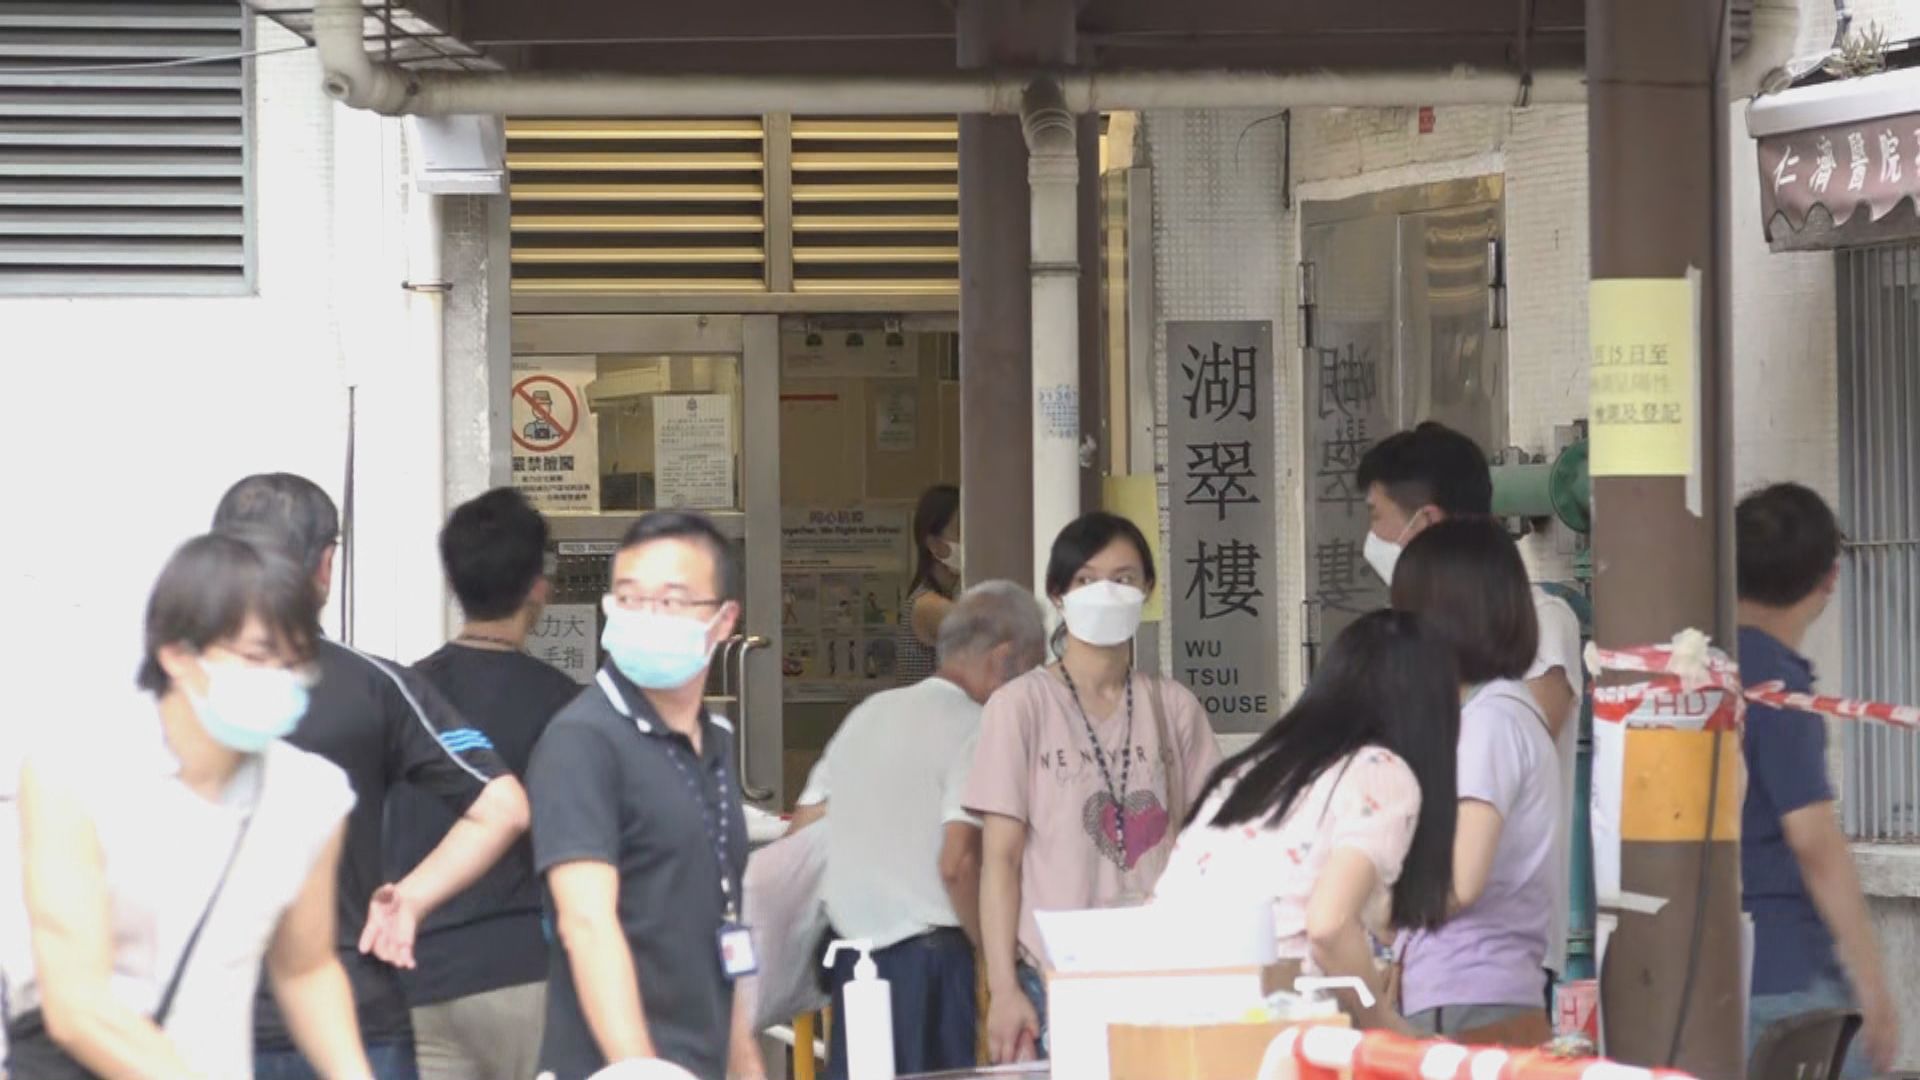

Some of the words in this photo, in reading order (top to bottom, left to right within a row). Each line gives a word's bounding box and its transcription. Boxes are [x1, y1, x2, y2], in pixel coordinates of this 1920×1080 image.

[1773, 128, 1920, 194] 仁濟醫院
[1182, 341, 1263, 619] 湖翠樓
[527, 645, 585, 670] 手指
[1184, 639, 1222, 658] WU
[1185, 667, 1239, 687] TSUI
[1198, 694, 1268, 714] OUSE
[1653, 691, 1706, 716] HD
